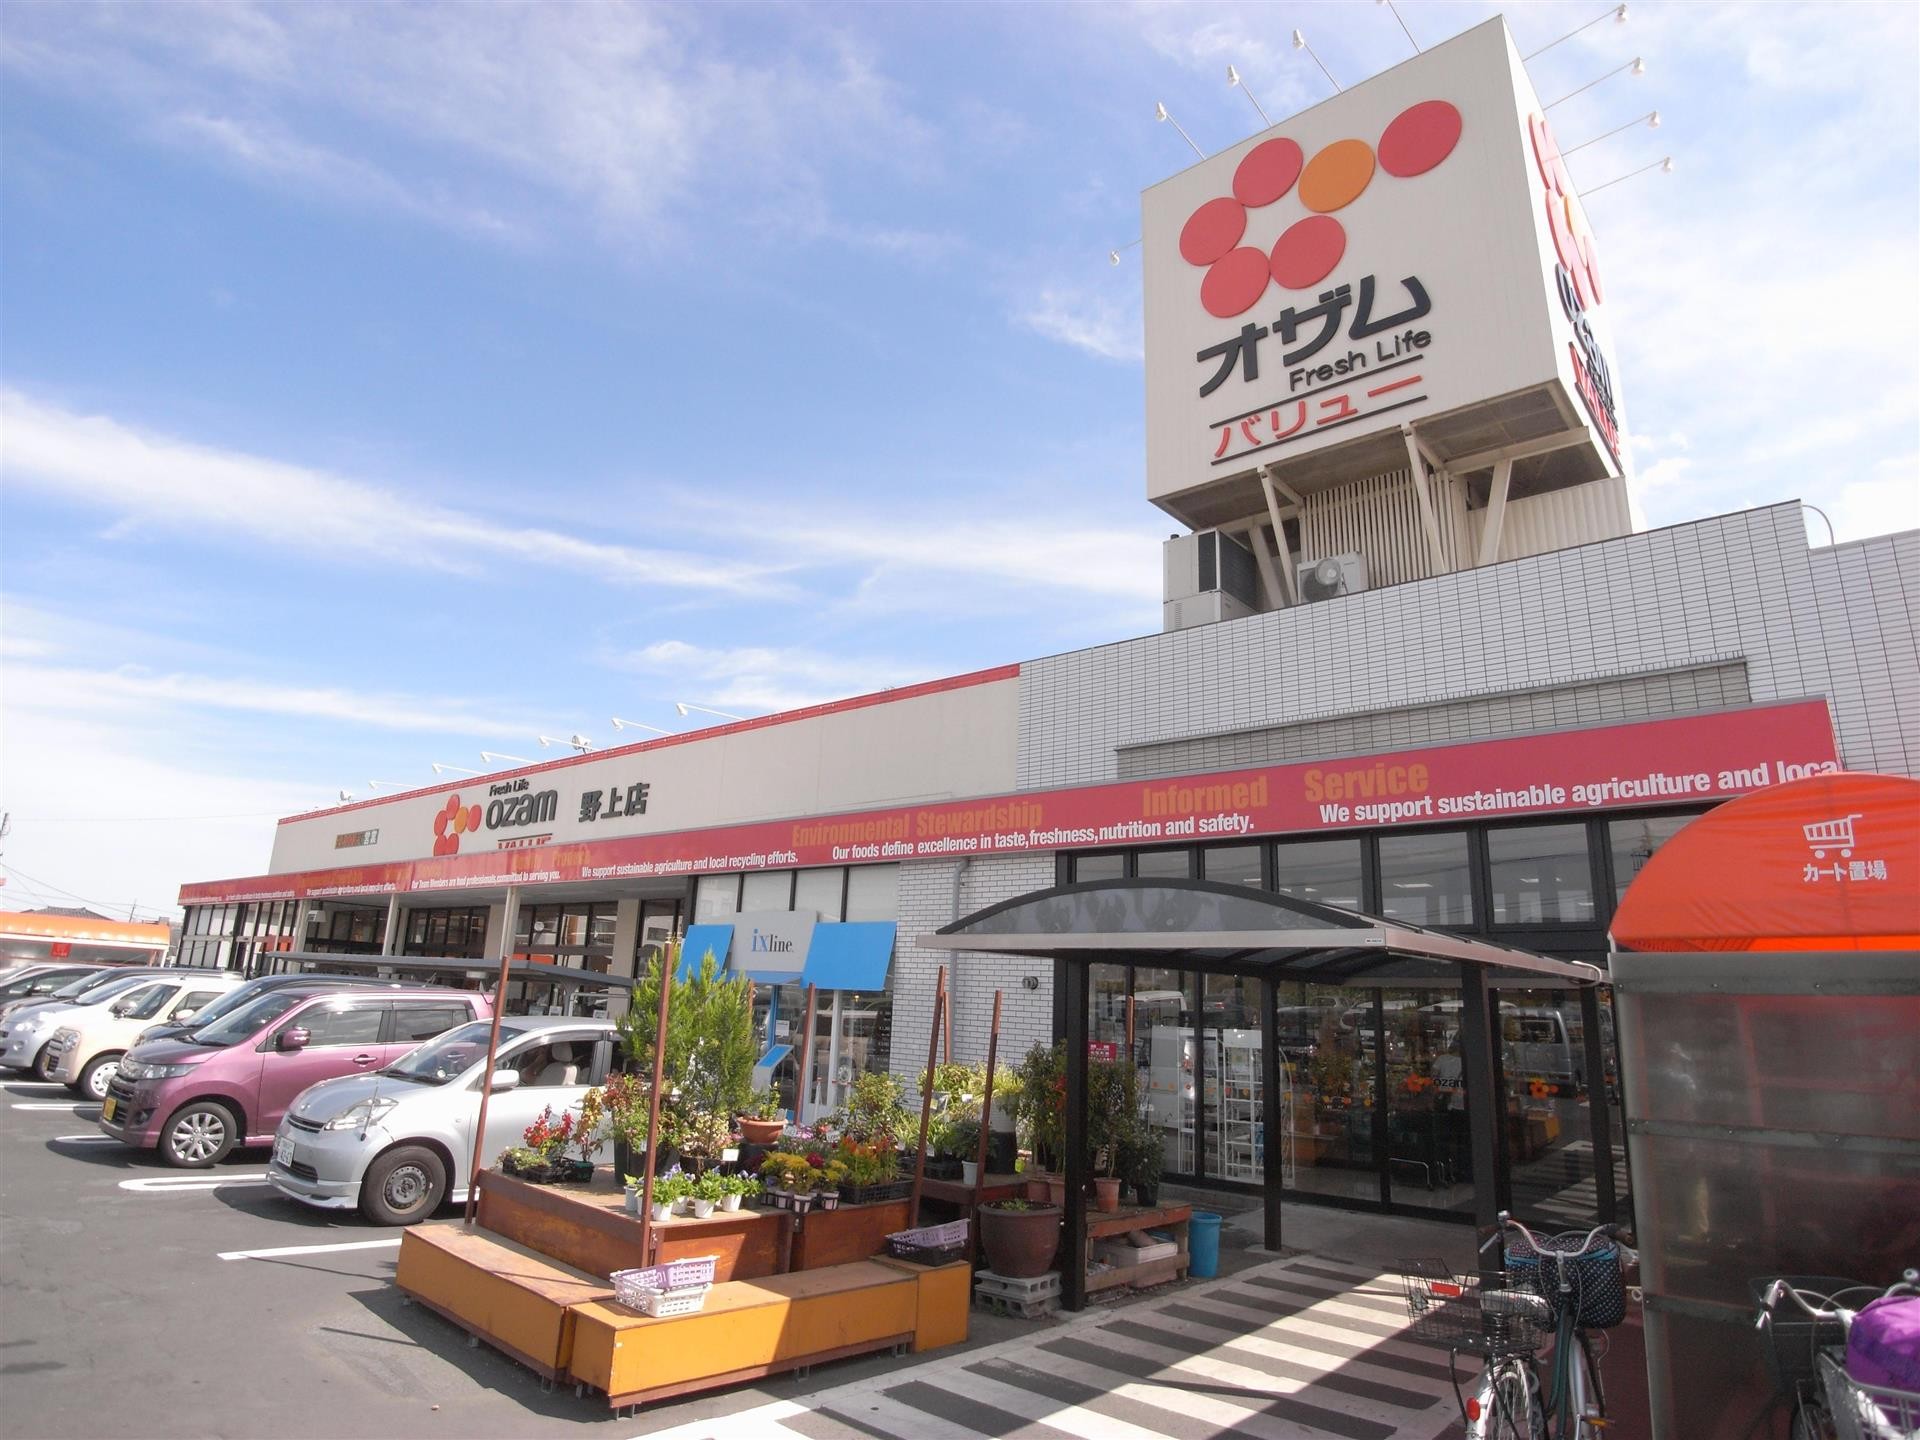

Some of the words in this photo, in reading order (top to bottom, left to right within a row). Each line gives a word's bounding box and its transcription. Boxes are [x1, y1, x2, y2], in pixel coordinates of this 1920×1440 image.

[1197, 274, 1431, 398] オザム
[1289, 351, 1366, 391] Fresh
[1377, 330, 1431, 361] Life
[1215, 375, 1422, 457] バリュー
[485, 789, 558, 830] ozam
[489, 783, 512, 797] Fresh
[578, 782, 650, 823] 野上店
[1143, 776, 1268, 817] Informed
[1304, 762, 1429, 801] Service
[1319, 804, 1350, 824] We
[1354, 796, 1433, 823] support
[1438, 784, 1565, 814] sustainable
[1571, 773, 1711, 806] agriculture
[1718, 763, 1770, 789] and
[792, 813, 910, 848] Environmental
[916, 801, 1043, 837] Stewardship
[832, 846, 850, 861] Our
[852, 843, 879, 859] foods
[882, 841, 914, 856] define
[918, 834, 977, 854] excellence
[980, 833, 992, 849] in
[1165, 816, 1195, 835] and
[1199, 813, 1255, 834] safety.
[592, 864, 616, 878] support
[617, 861, 653, 875] sustainable
[654, 859, 692, 875] agriculture
[693, 857, 708, 870] and
[709, 856, 728, 868] local
[729, 852, 766, 869] recycling
[1803, 860, 1887, 882] カート置場
